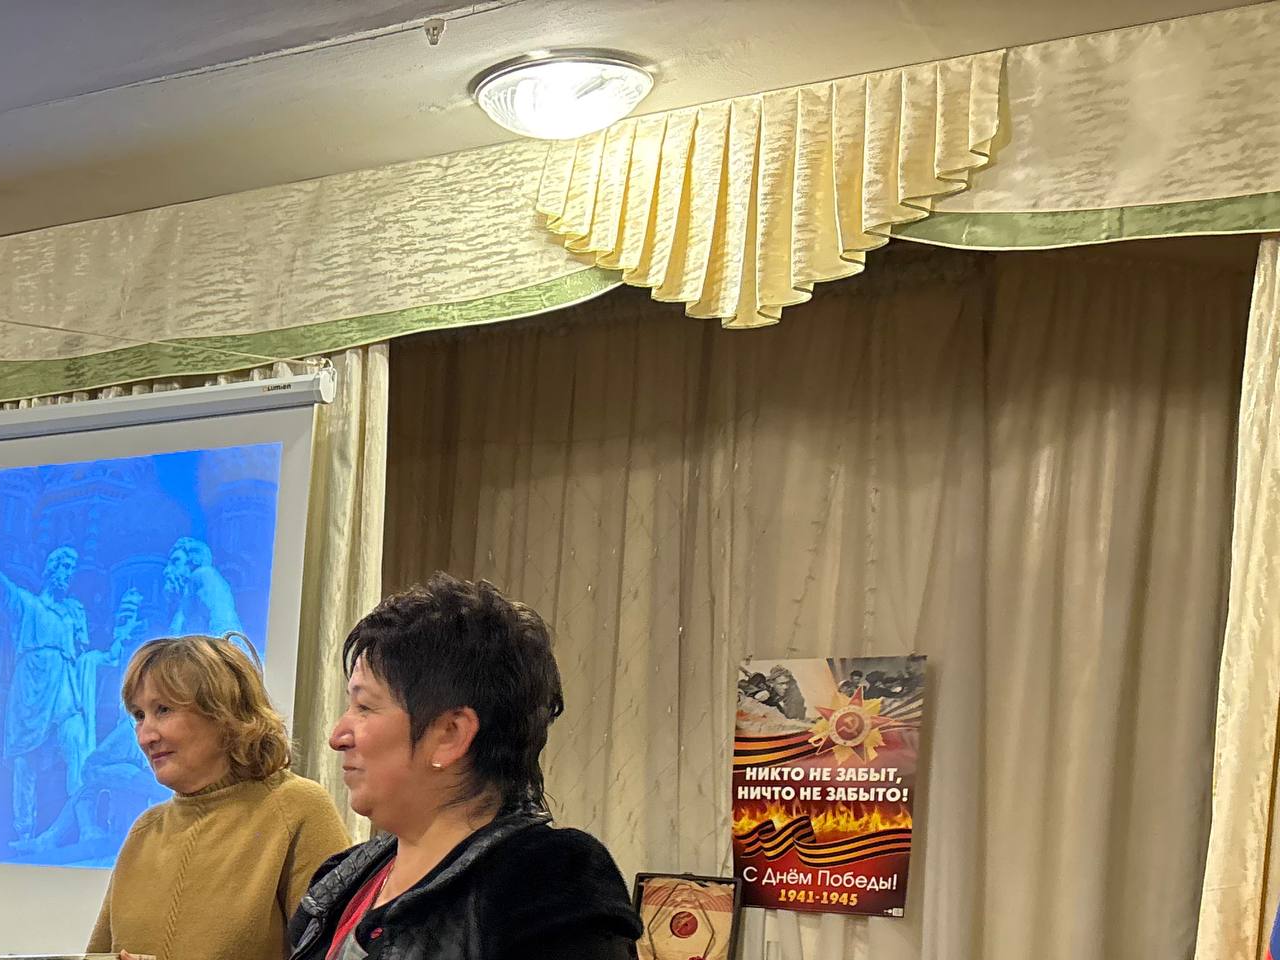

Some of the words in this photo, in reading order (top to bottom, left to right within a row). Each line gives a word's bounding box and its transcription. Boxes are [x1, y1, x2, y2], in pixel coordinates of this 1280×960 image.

[745, 767, 804, 781] НИКТО
[809, 767, 832, 781] НЕ
[836, 767, 902, 784] ЗАБЫТ,
[737, 786, 796, 800] НИЧТО
[800, 786, 821, 800] НЕ
[826, 787, 908, 802] ЗАБЫТО!
[743, 866, 758, 882] С
[762, 867, 812, 886] Днём
[818, 870, 897, 891] Победы!
[778, 888, 858, 906] 1941-1945
